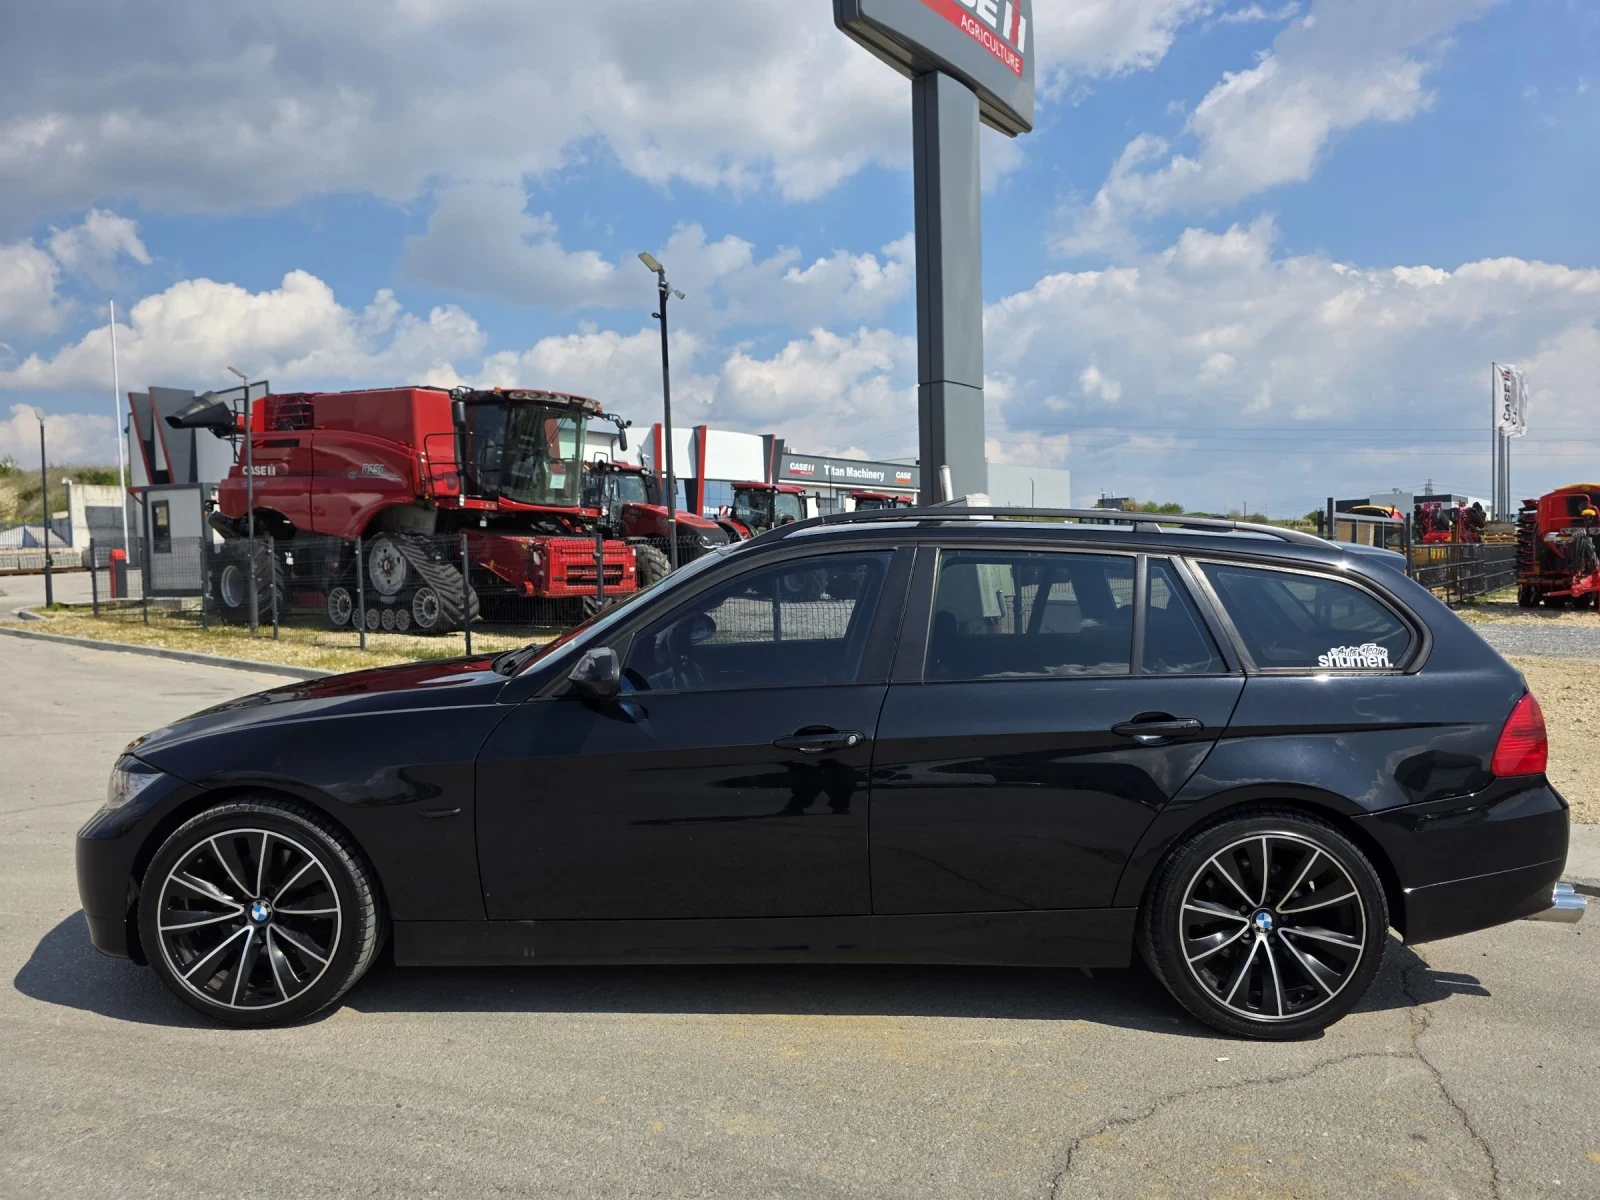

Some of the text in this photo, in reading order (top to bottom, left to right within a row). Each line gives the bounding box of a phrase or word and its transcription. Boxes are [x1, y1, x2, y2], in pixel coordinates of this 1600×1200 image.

[961, 14, 1020, 73] AGRICULTURE
[846, 467, 885, 482] Machinery
[896, 471, 912, 480] CASE
[1360, 643, 1388, 658] Team
